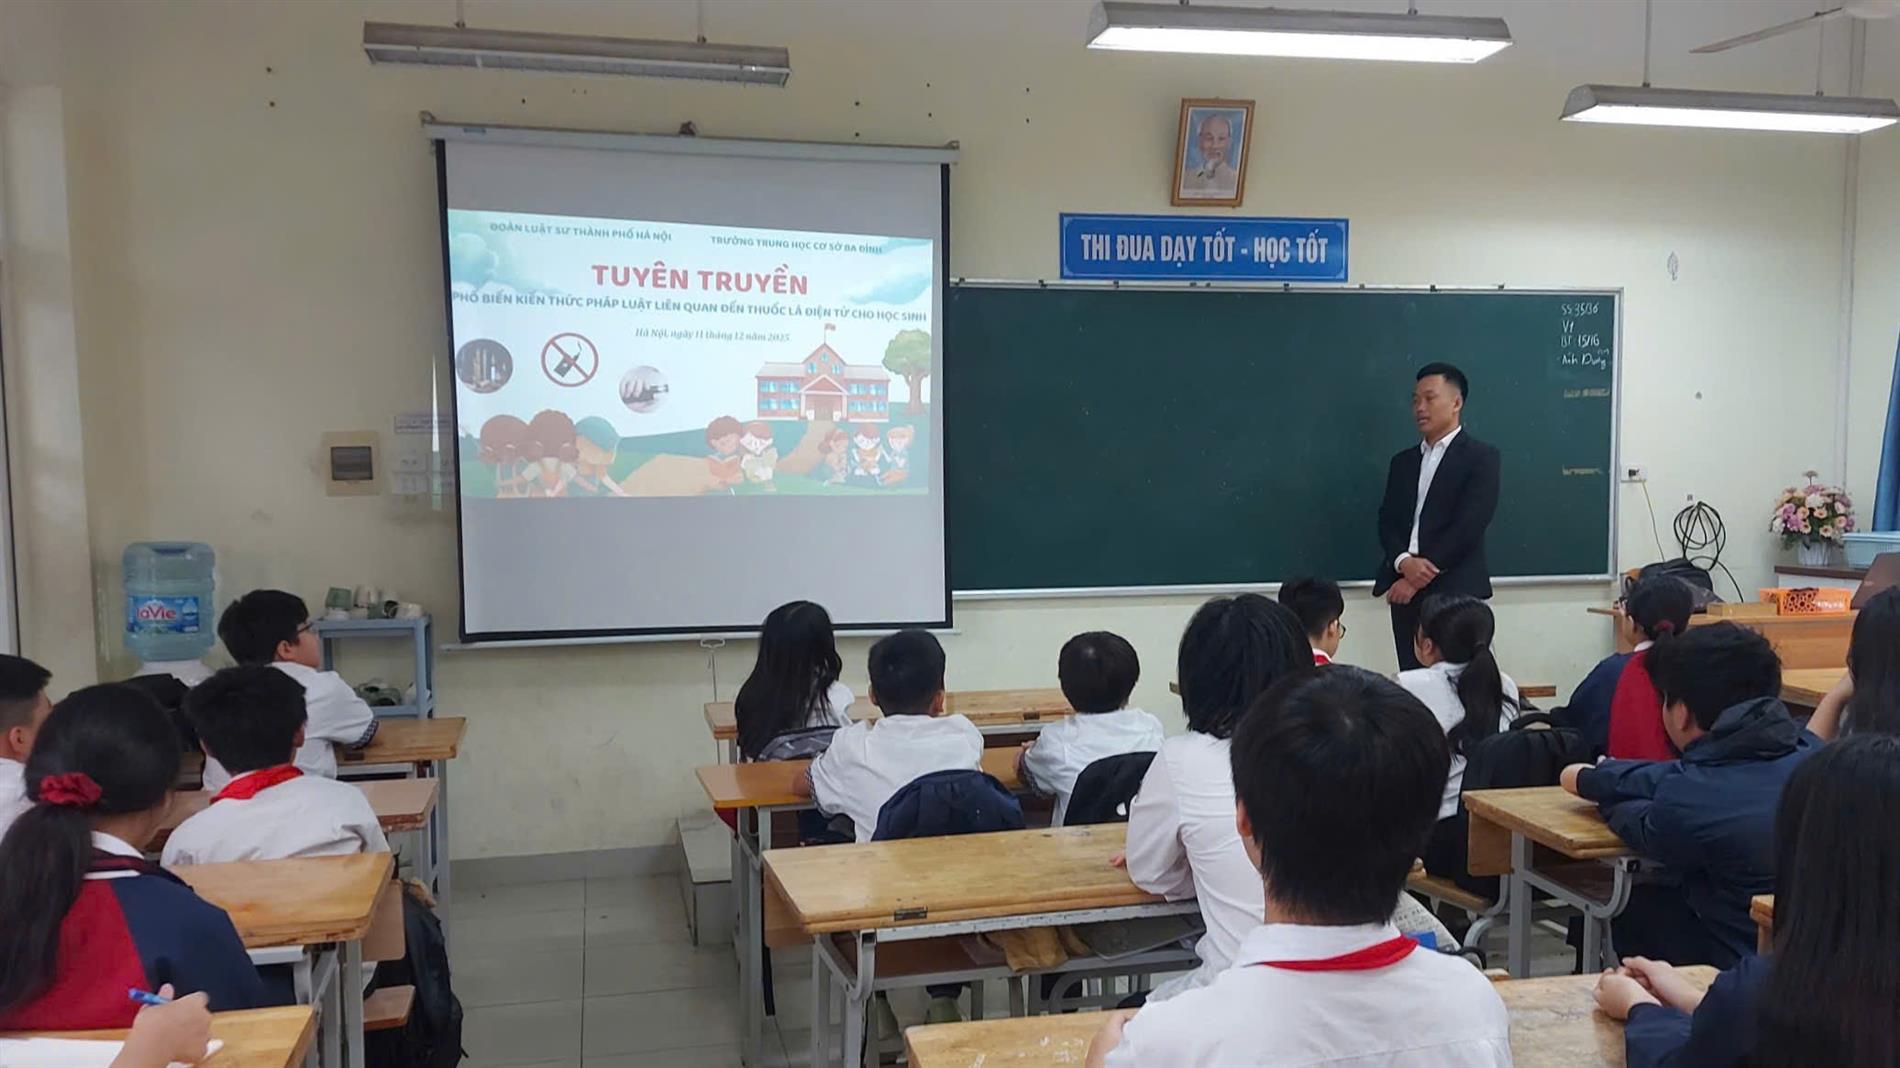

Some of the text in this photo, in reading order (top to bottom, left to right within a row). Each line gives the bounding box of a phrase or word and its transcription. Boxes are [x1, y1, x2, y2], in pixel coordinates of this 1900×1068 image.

[489, 220, 523, 233] ĐOÀN
[524, 222, 553, 237] LUẬT
[555, 226, 571, 236] SƯ
[573, 225, 610, 238] THÀNH
[612, 227, 634, 240] PHỐ
[652, 230, 673, 243] NỘI
[710, 234, 883, 255] TRƯỜNG TRUNG HỌC CƠ SỞ BA ĐÌNH
[1080, 233, 1111, 261] THI
[1116, 234, 1155, 262] ĐUA
[1160, 235, 1198, 268] DẠY
[1202, 227, 1236, 263] TỐT
[1253, 236, 1292, 269] HỌC
[1296, 228, 1329, 264] TỐT
[591, 260, 809, 295] TUYÊN TRUYỀN
[482, 289, 513, 305] BIẾN
[548, 294, 584, 307] THỨC
[586, 296, 620, 309] PHÁP
[621, 297, 653, 313] LUẬT
[654, 298, 682, 312] LIÊN
[682, 302, 719, 314] QUAN
[720, 300, 745, 315] ĐẾN
[747, 302, 786, 316] THUỐC
[804, 304, 832, 320] ĐIỆN
[833, 306, 851, 318] TỬ
[851, 309, 875, 320] CHO
[876, 310, 900, 323] HỌC
[901, 312, 928, 322] SINH
[635, 327, 650, 338] Hà
[670, 329, 694, 341] ngày
[705, 330, 734, 341] tháng
[735, 331, 745, 341] 12
[767, 333, 790, 343] 2025
